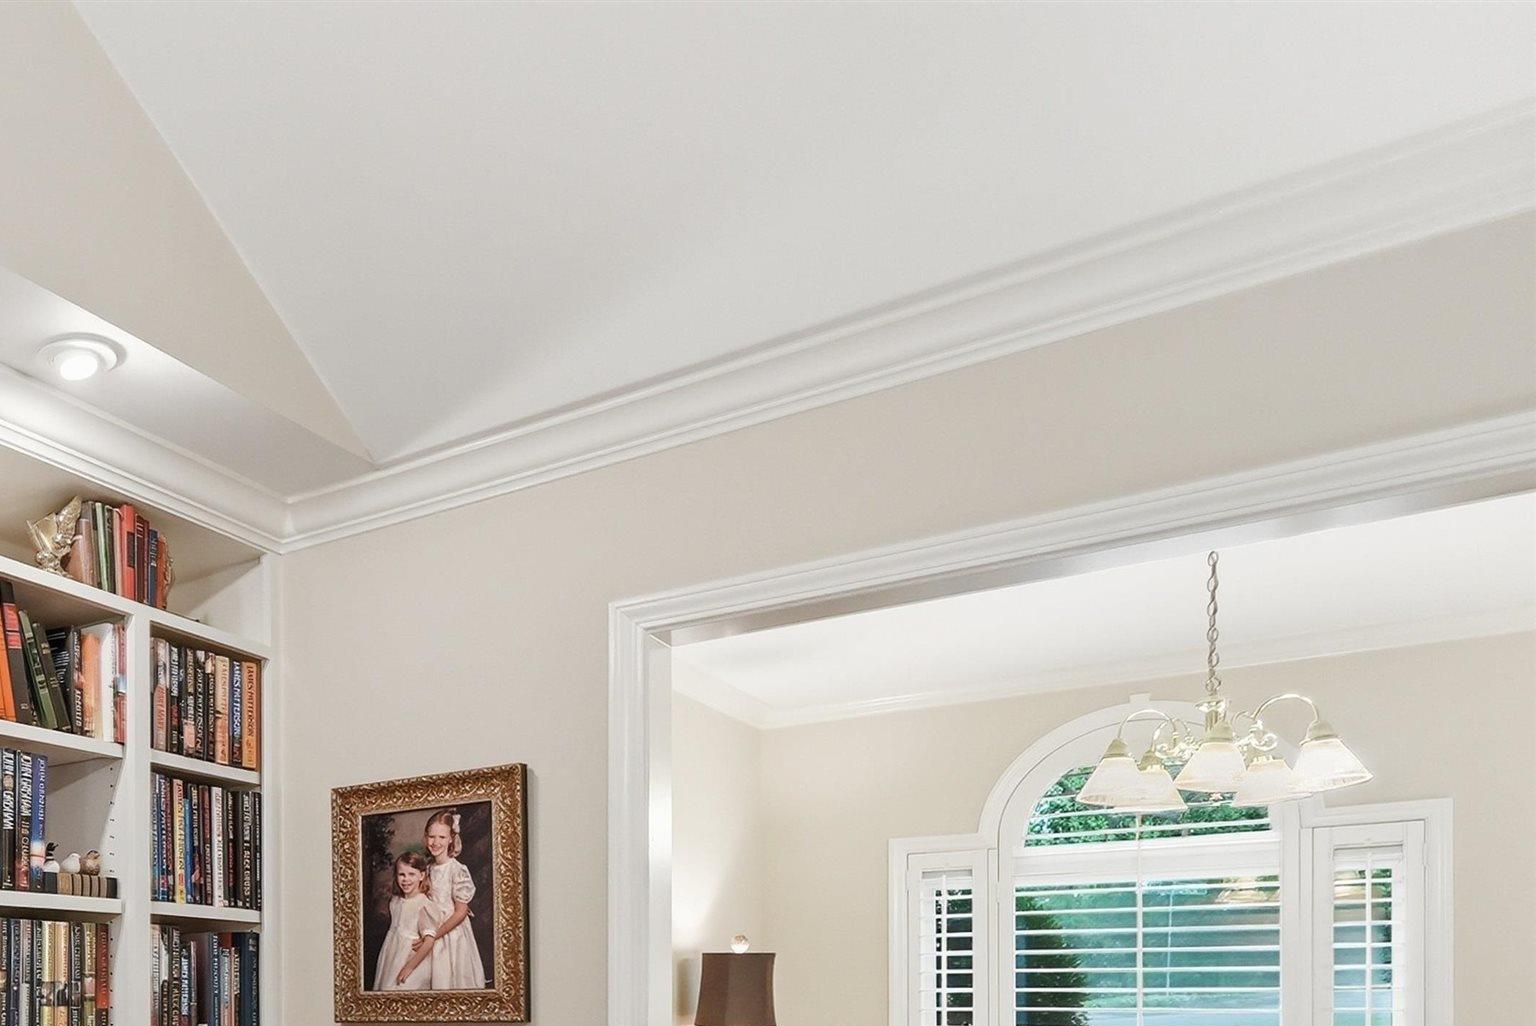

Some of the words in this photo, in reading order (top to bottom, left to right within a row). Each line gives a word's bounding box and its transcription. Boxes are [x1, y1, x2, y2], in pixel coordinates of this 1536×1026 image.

[233, 661, 241, 688] JAMES
[233, 688, 241, 735] PATTERSON
[20, 755, 32, 777] JOHN
[2, 791, 14, 830] GRISHAM
[20, 778, 31, 817] GRISHAM
